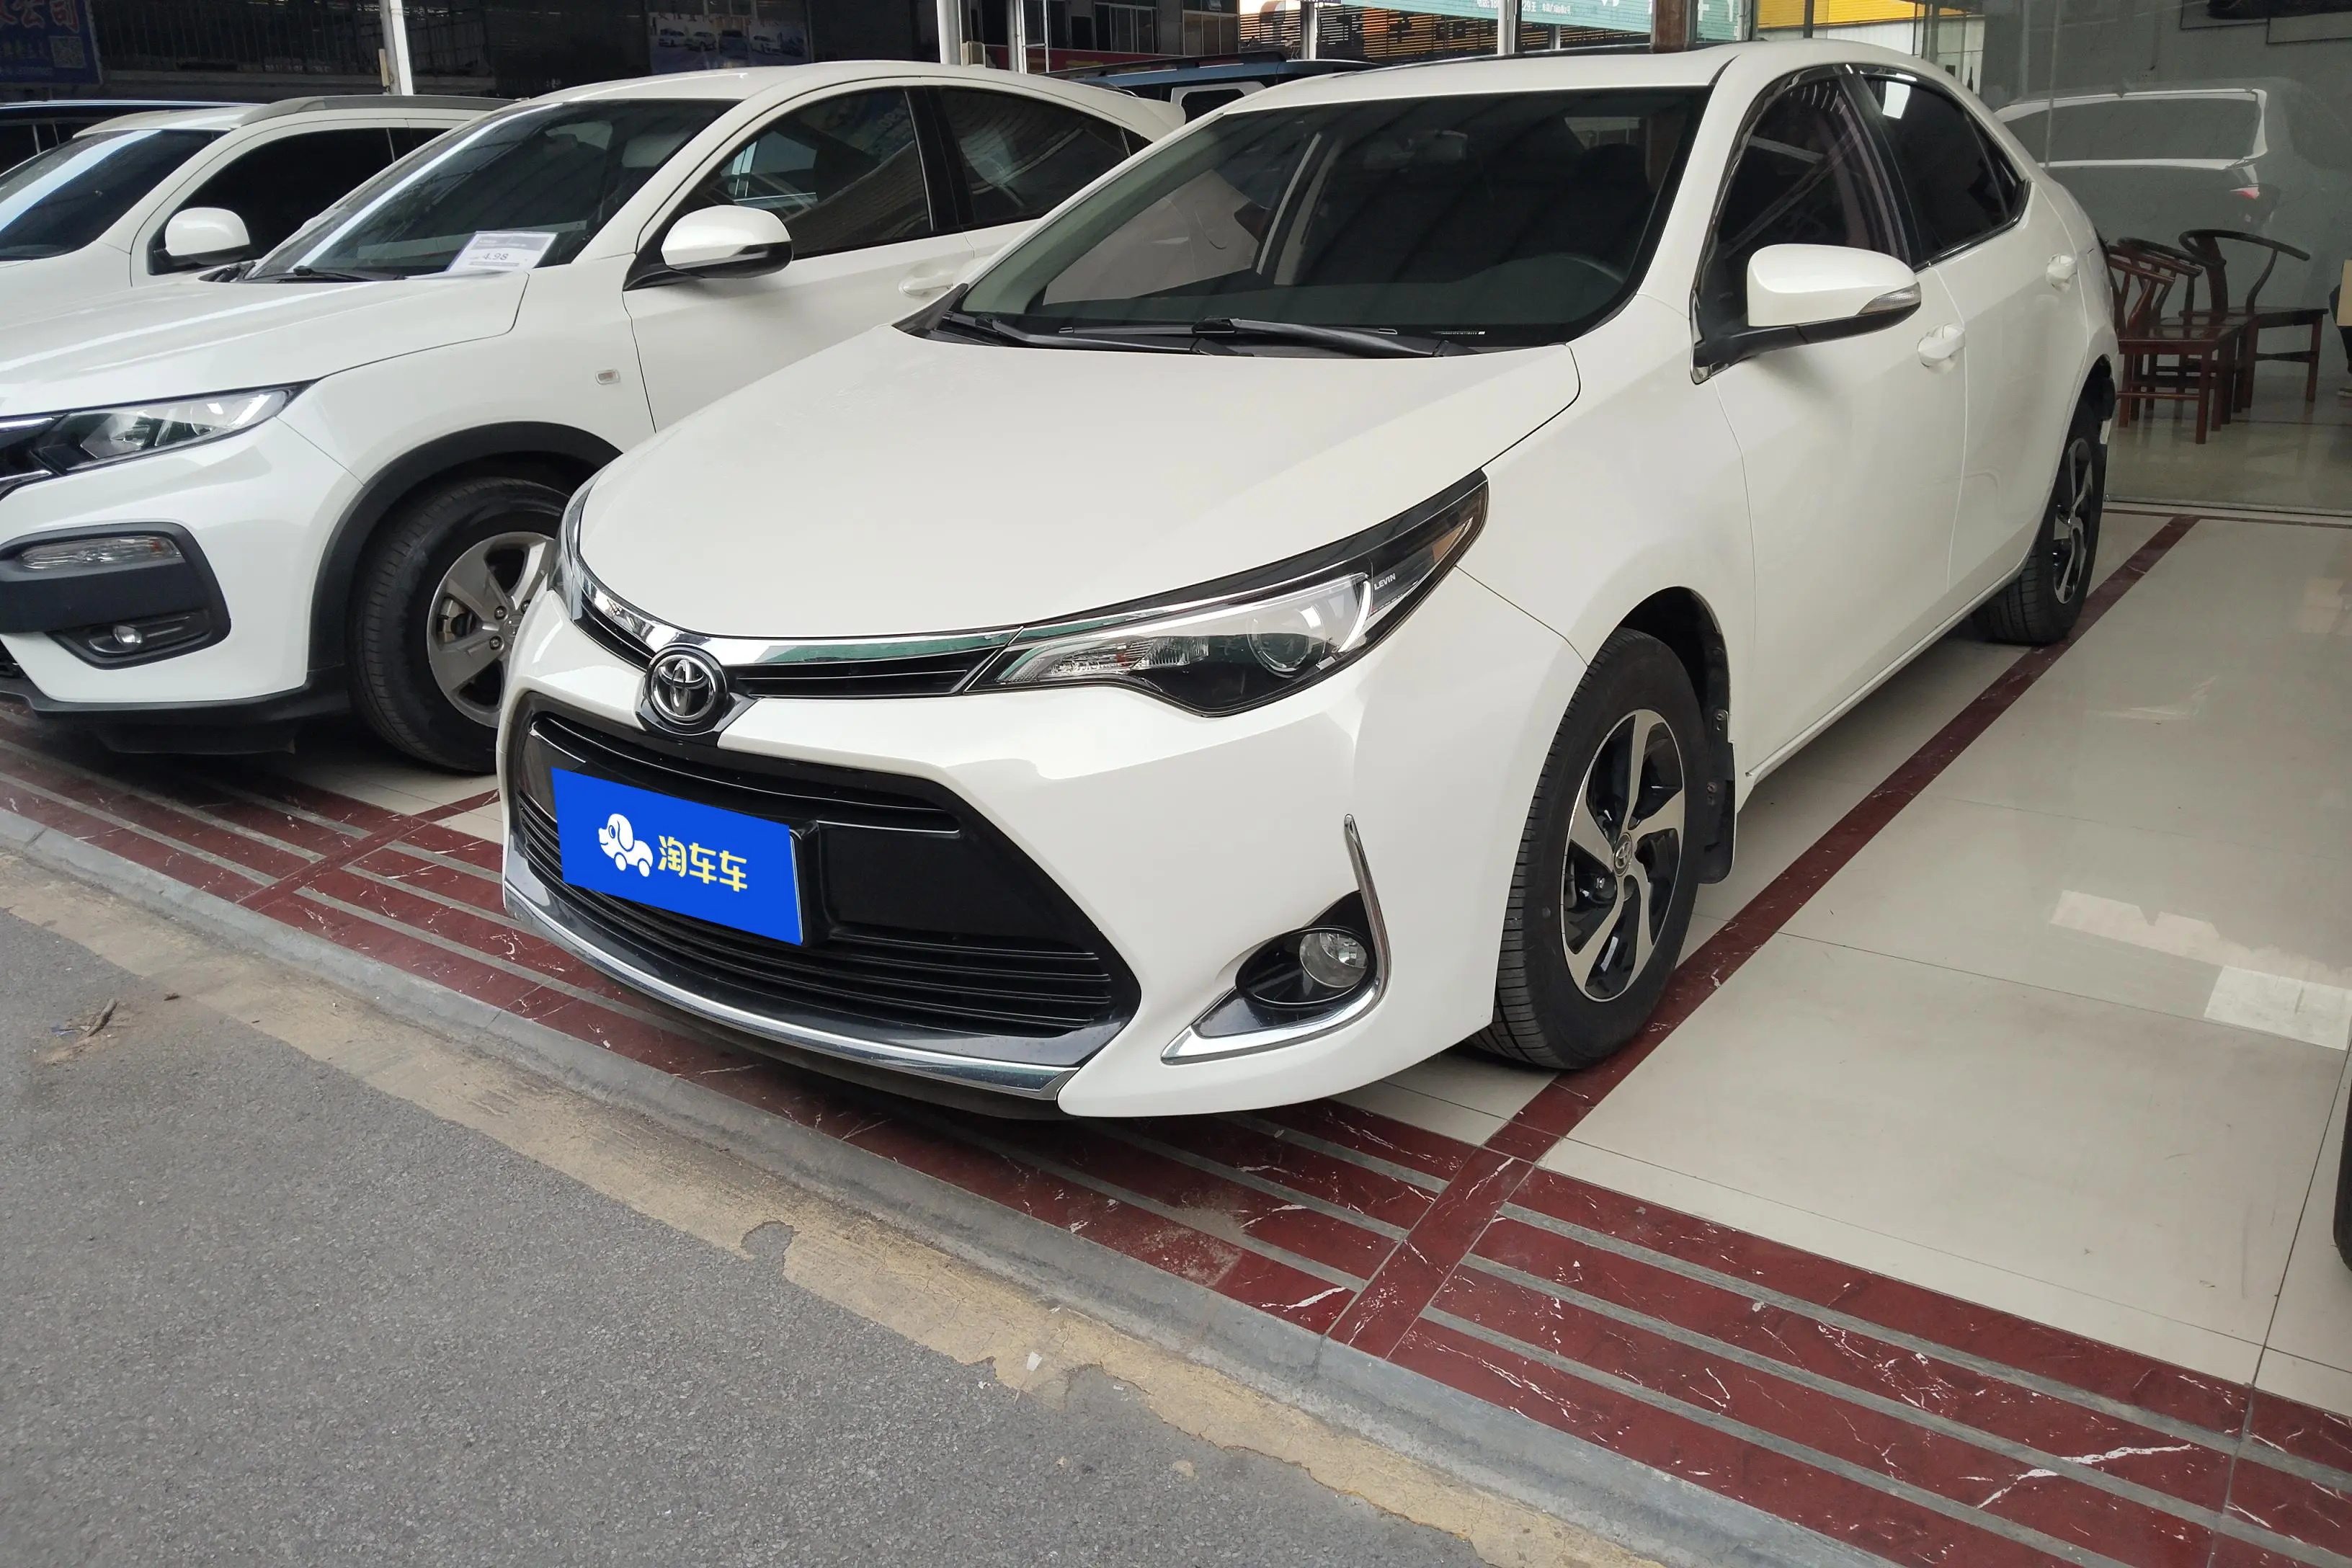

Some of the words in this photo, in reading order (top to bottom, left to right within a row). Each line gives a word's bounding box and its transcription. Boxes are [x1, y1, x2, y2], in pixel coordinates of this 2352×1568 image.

[1522, 0, 1537, 12] 29王
[0, 0, 79, 33] 公司
[1373, 573, 1396, 591] LEVIN
